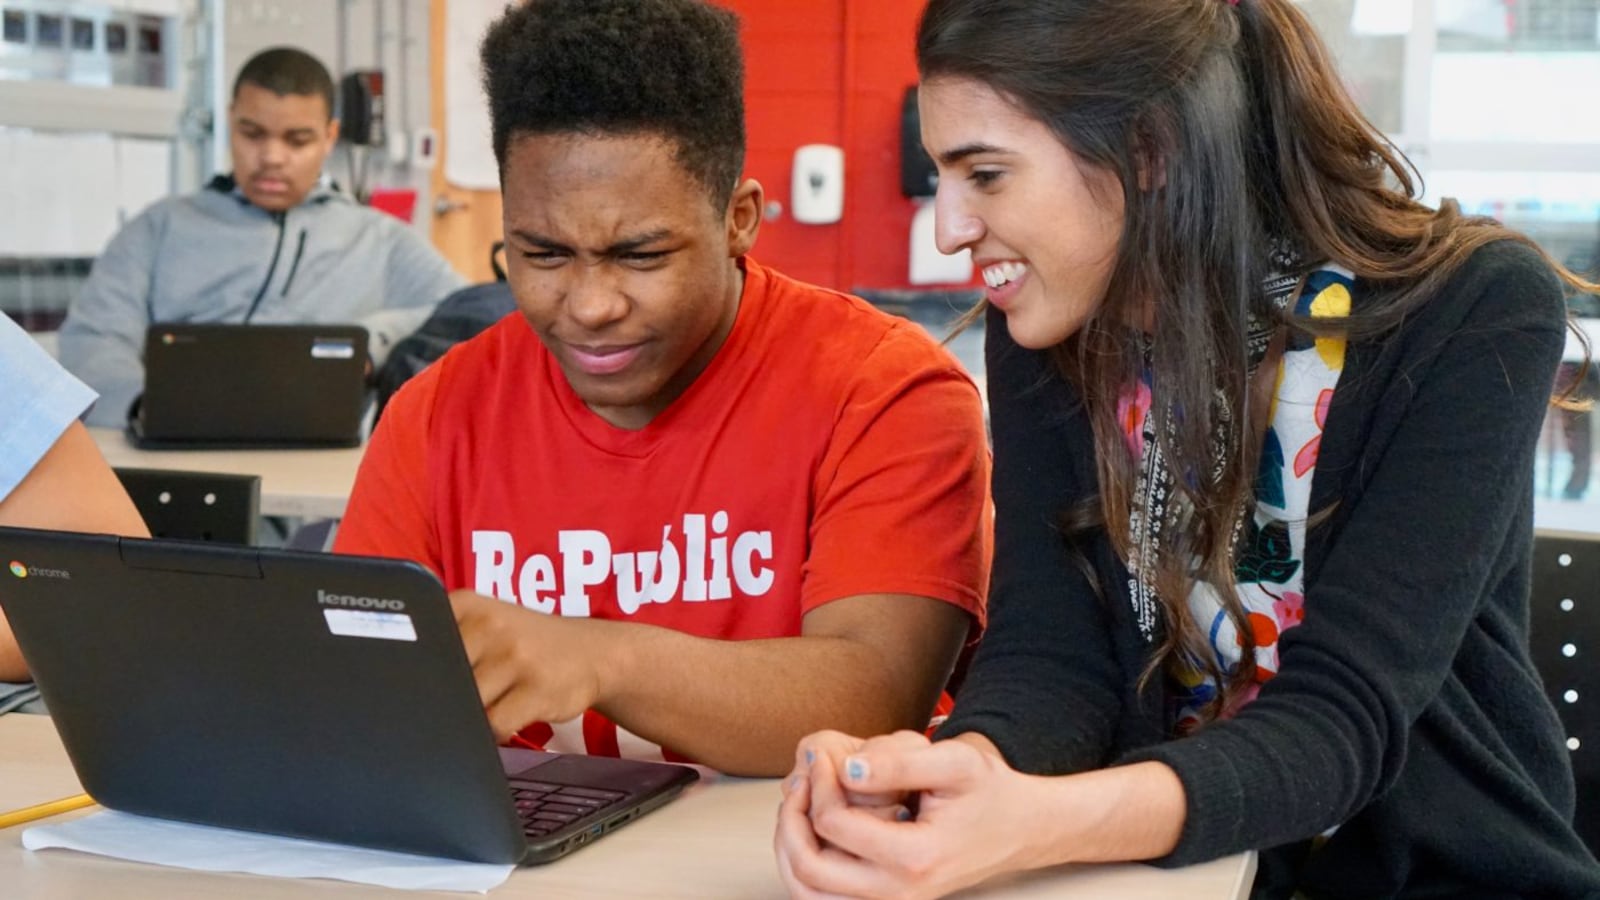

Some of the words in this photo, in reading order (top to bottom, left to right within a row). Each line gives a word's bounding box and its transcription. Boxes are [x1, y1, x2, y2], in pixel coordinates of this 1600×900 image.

[28, 564, 71, 580] chrome
[471, 510, 775, 617] RePublic
[317, 589, 405, 610] lenovo
